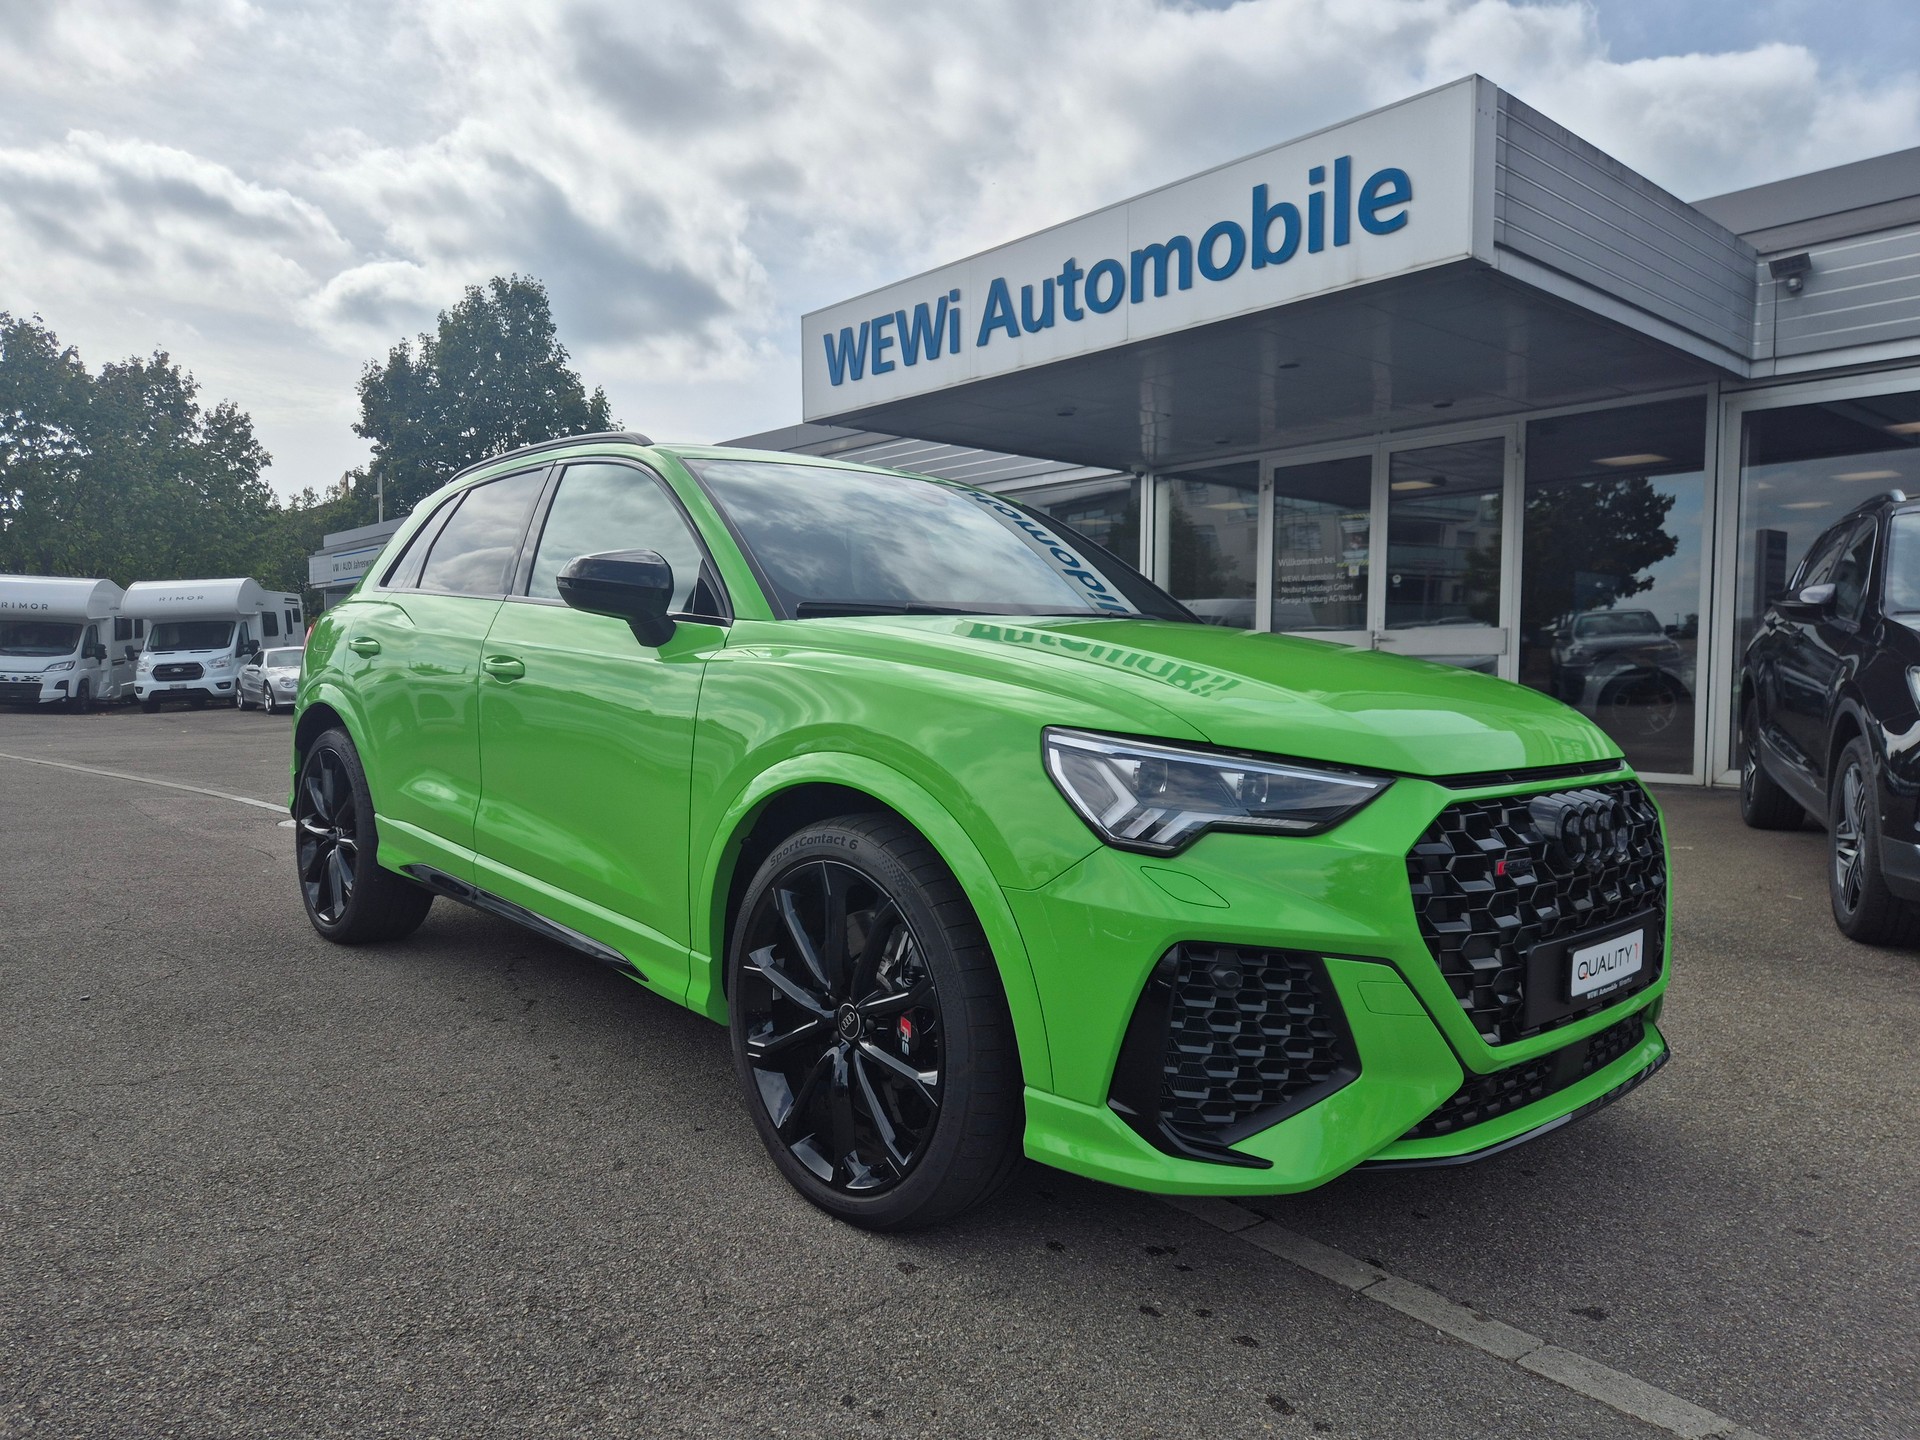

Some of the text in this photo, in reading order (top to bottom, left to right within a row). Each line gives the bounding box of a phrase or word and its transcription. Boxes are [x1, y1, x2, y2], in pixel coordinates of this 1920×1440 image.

[823, 155, 1412, 386] WEWi Automobile
[1278, 555, 1336, 567] Willkommen bei
[1, 602, 48, 610] RIMOR
[770, 833, 859, 867] SportContact 6
[1578, 943, 1639, 980] QUALITY 1
[901, 1025, 910, 1056] RS
